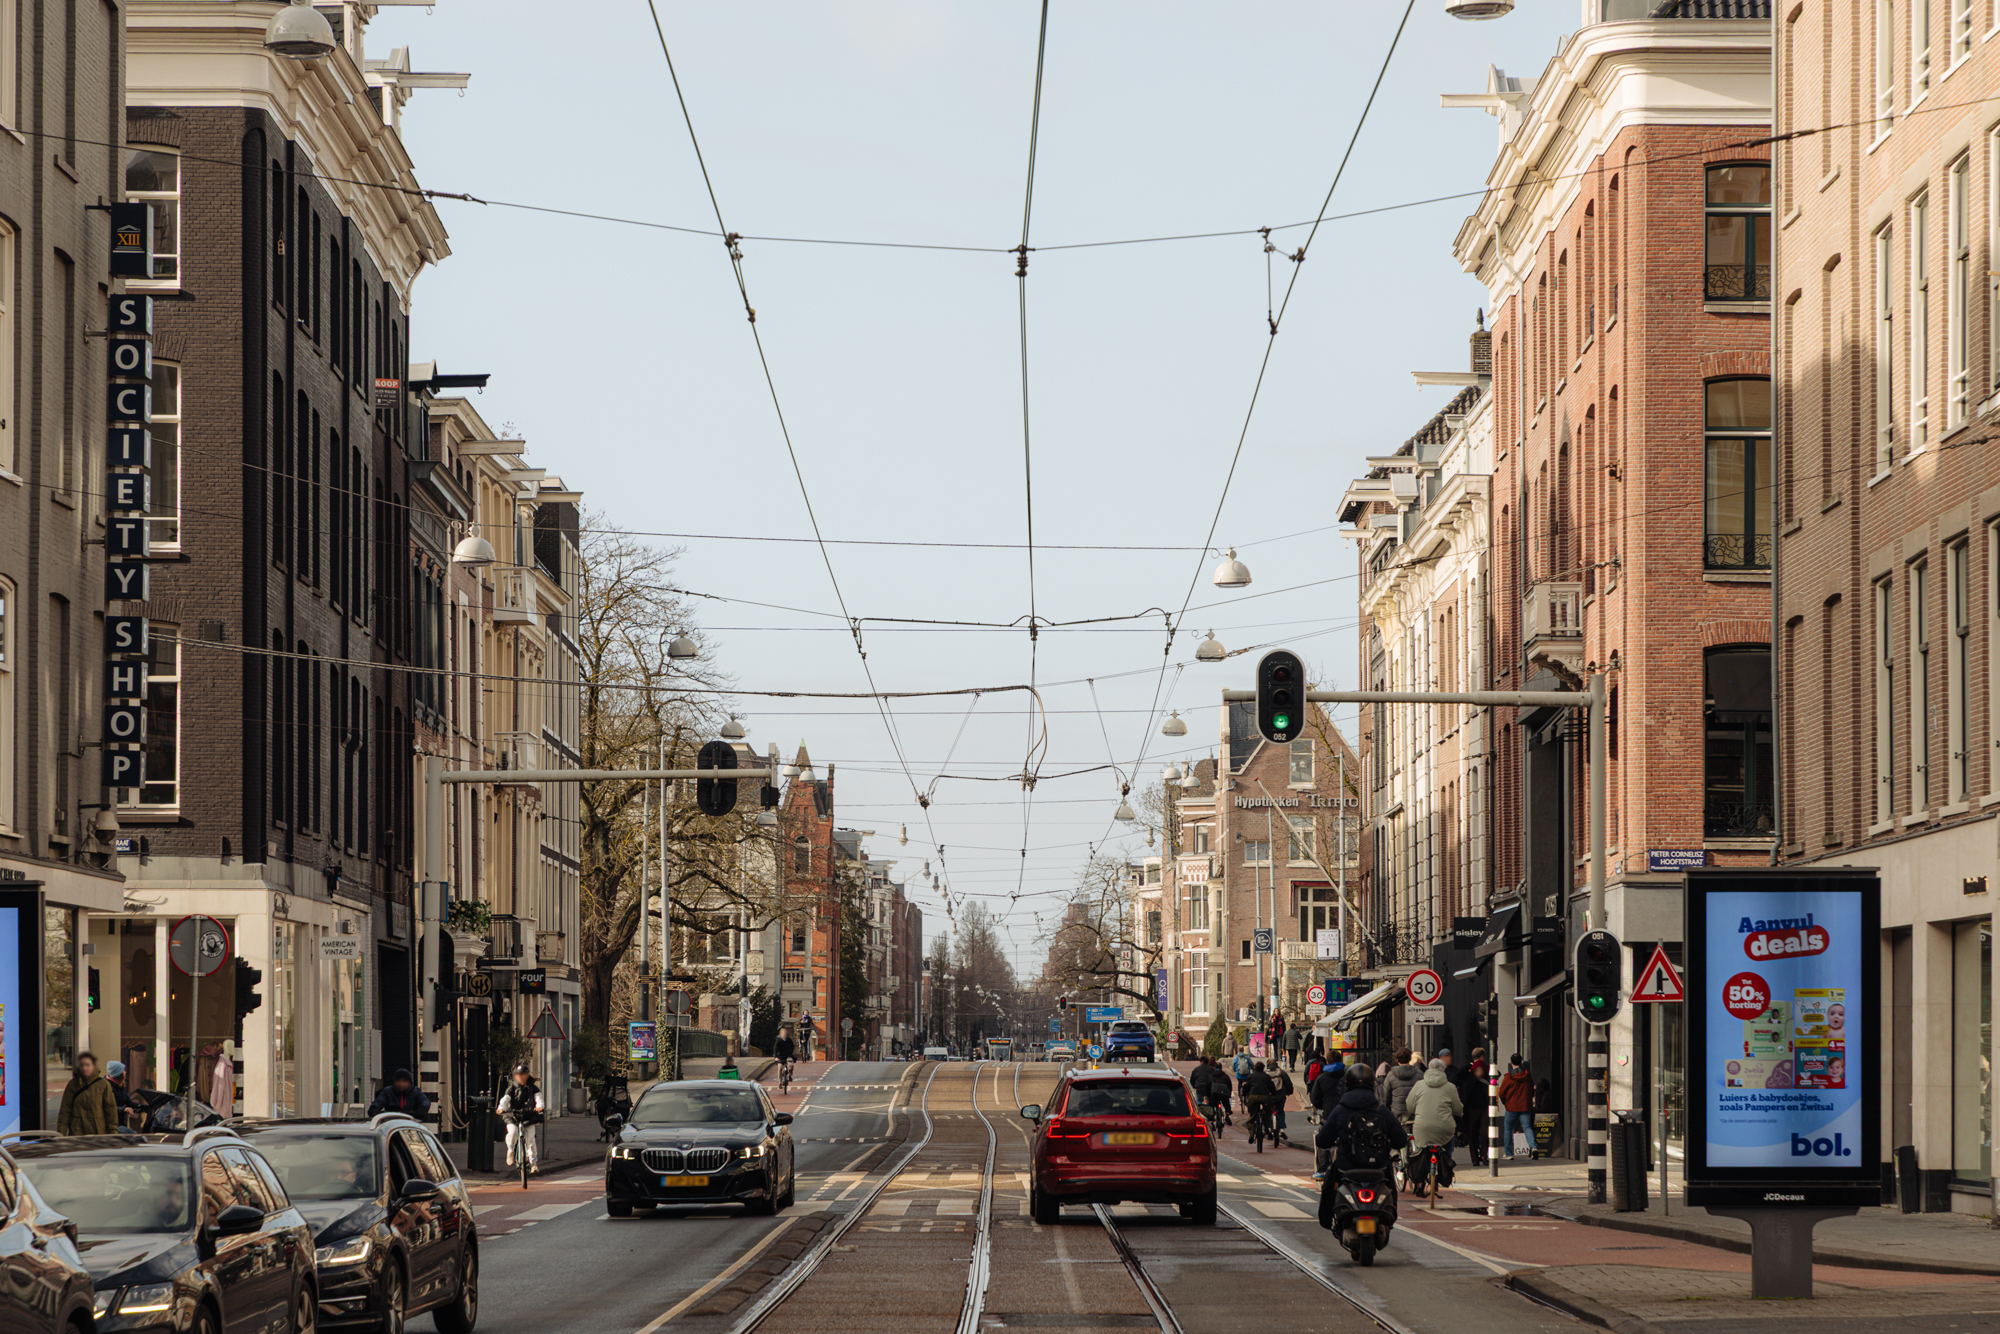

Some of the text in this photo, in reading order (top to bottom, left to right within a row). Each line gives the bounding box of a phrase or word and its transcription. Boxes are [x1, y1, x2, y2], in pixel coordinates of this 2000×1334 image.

[117, 233, 140, 246] XIII
[375, 380, 398, 388] KOOP
[114, 299, 140, 594] SOCIETY
[110, 621, 136, 781] SHOP
[1273, 733, 1287, 741] 052
[1738, 912, 1814, 933] Aanvul
[1455, 929, 1484, 938] sisley
[1592, 932, 1604, 940] 051
[321, 940, 356, 948] AMERICAN
[1750, 930, 1824, 957] deals
[324, 948, 353, 956] VINTAGE
[1159, 979, 1167, 998] OSK
[1414, 981, 1436, 994] 30
[1310, 991, 1323, 999] 30
[1729, 985, 1765, 1001] 50%
[1800, 1005, 1827, 1014] Pampers
[1800, 1052, 1828, 1061] Pampers
[1719, 1093, 1821, 1103] Luiers & babydoekjes,
[1719, 1103, 1743, 1111] zoals
[1744, 1103, 1785, 1112] Pampers
[1800, 1103, 1834, 1111] Zwitsal
[1791, 1132, 1851, 1157] bol.
[1763, 1193, 1806, 1201] JCDecaux
